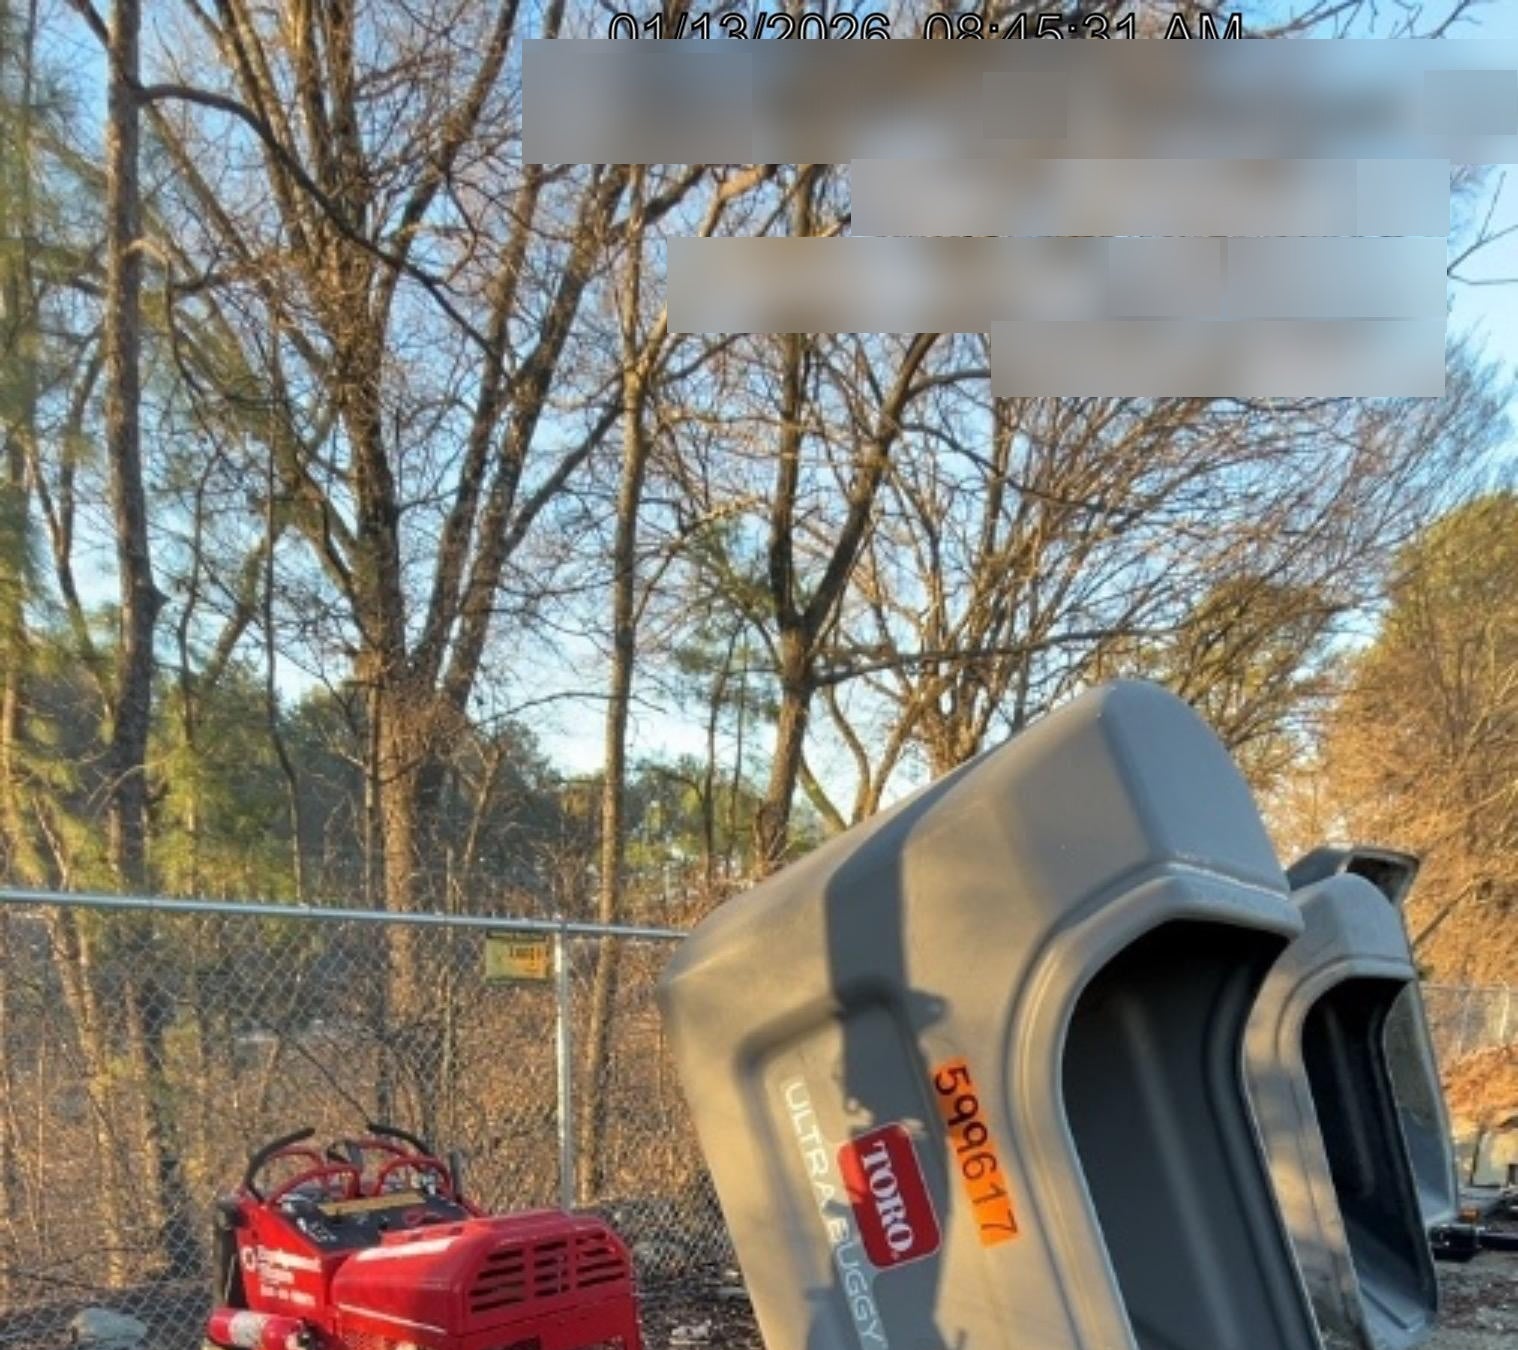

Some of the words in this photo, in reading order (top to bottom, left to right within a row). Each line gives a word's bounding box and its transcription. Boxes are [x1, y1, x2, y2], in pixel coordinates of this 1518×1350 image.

[785, 1081, 834, 1214] ULTRA
[861, 1139, 913, 1252] TORO
[935, 1065, 1018, 1235] 599617
